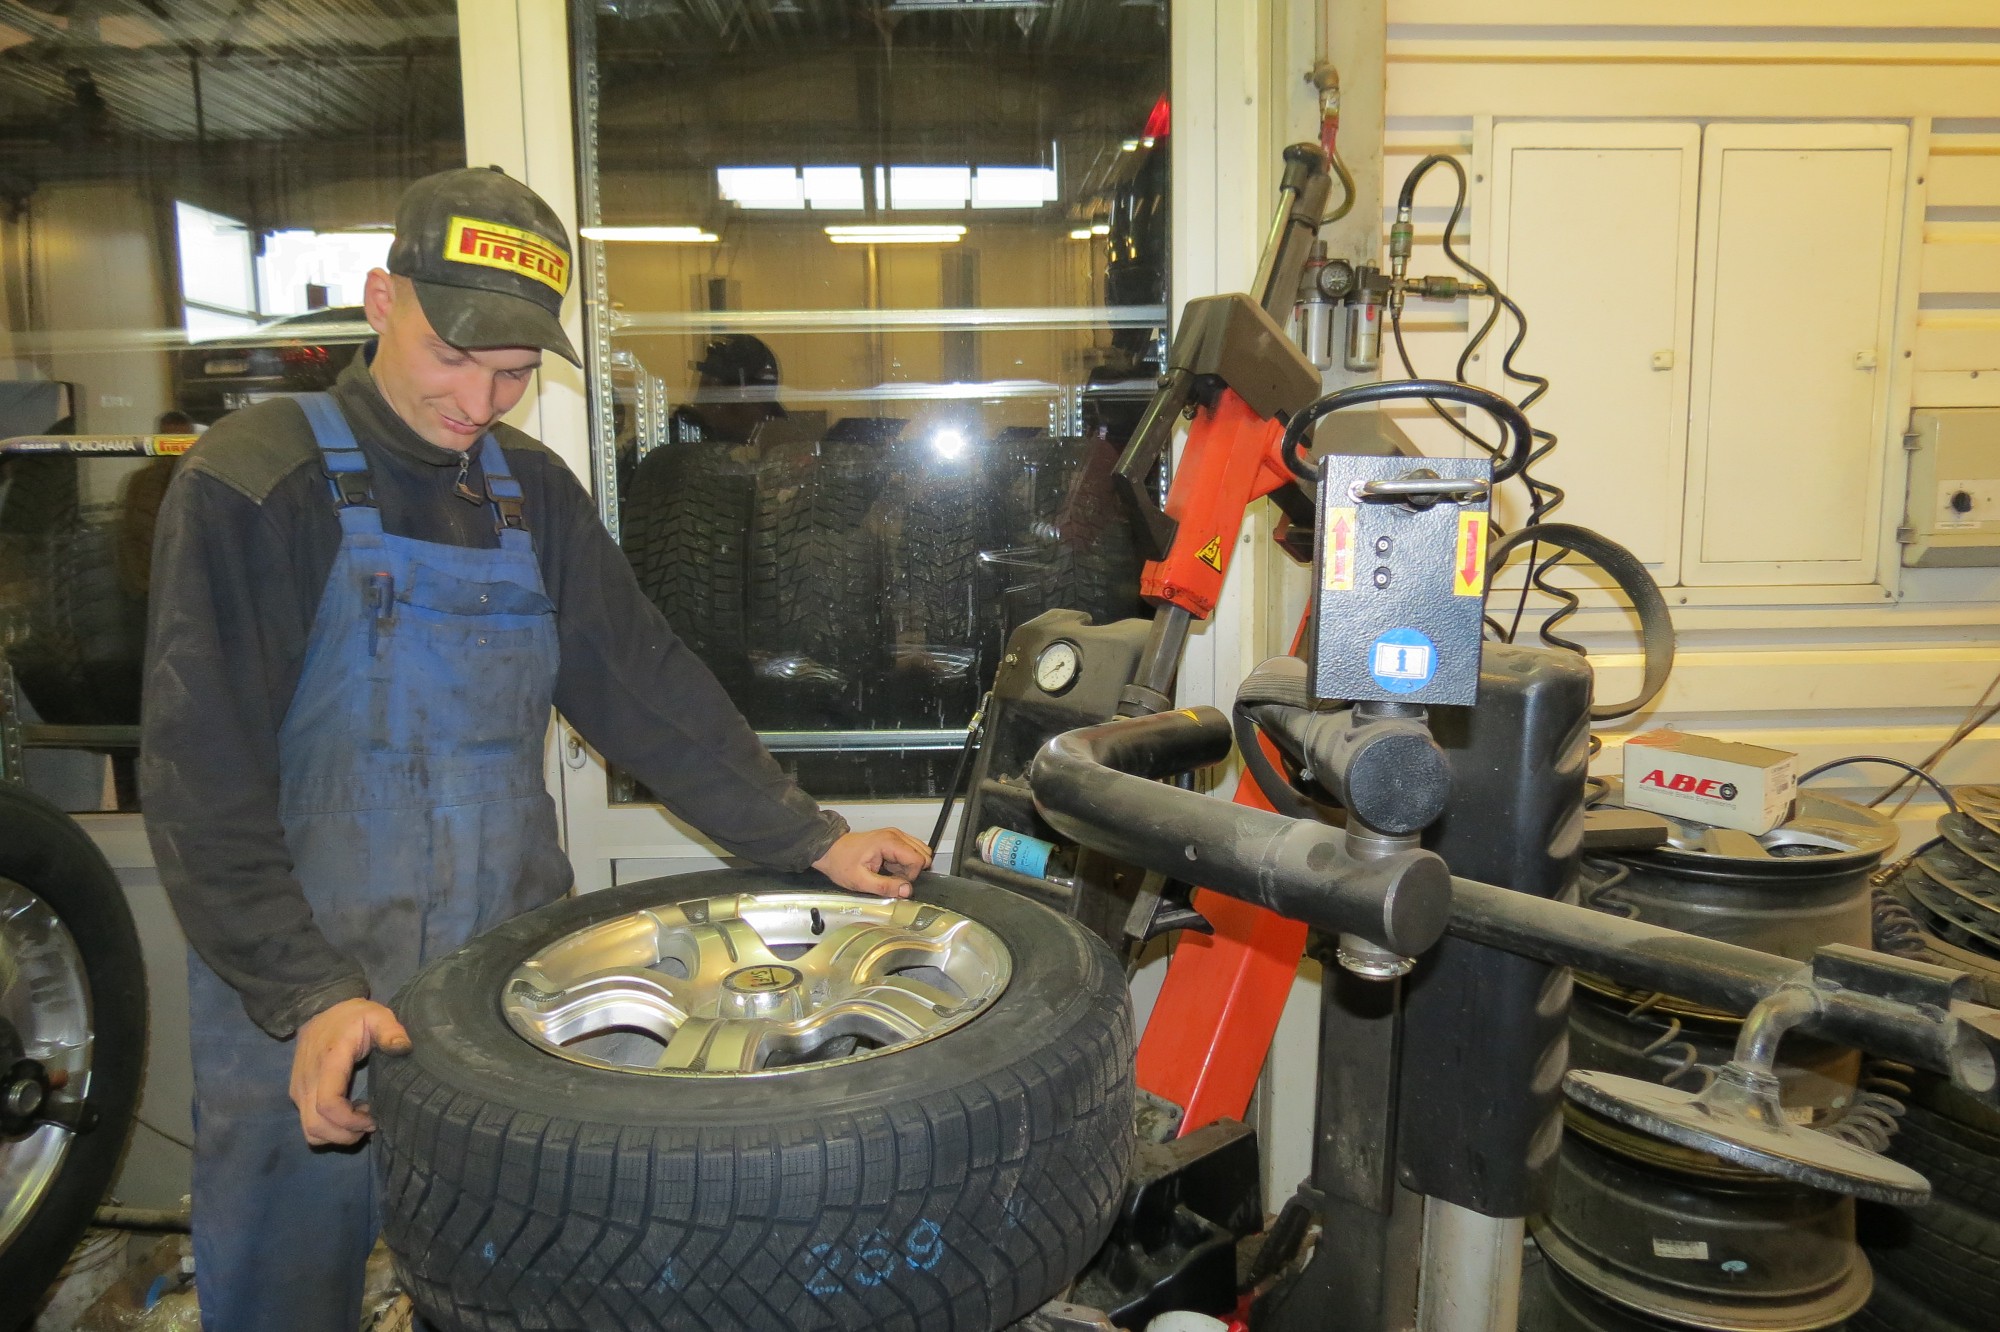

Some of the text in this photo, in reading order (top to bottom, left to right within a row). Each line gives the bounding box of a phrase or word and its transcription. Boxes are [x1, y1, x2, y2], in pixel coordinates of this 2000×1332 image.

[460, 227, 564, 284] PIRELLI
[68, 440, 136, 452] YOKOHAMA
[1639, 769, 1723, 799] ABE
[1695, 795, 1737, 811] Engineering
[804, 1217, 944, 1296] 259
